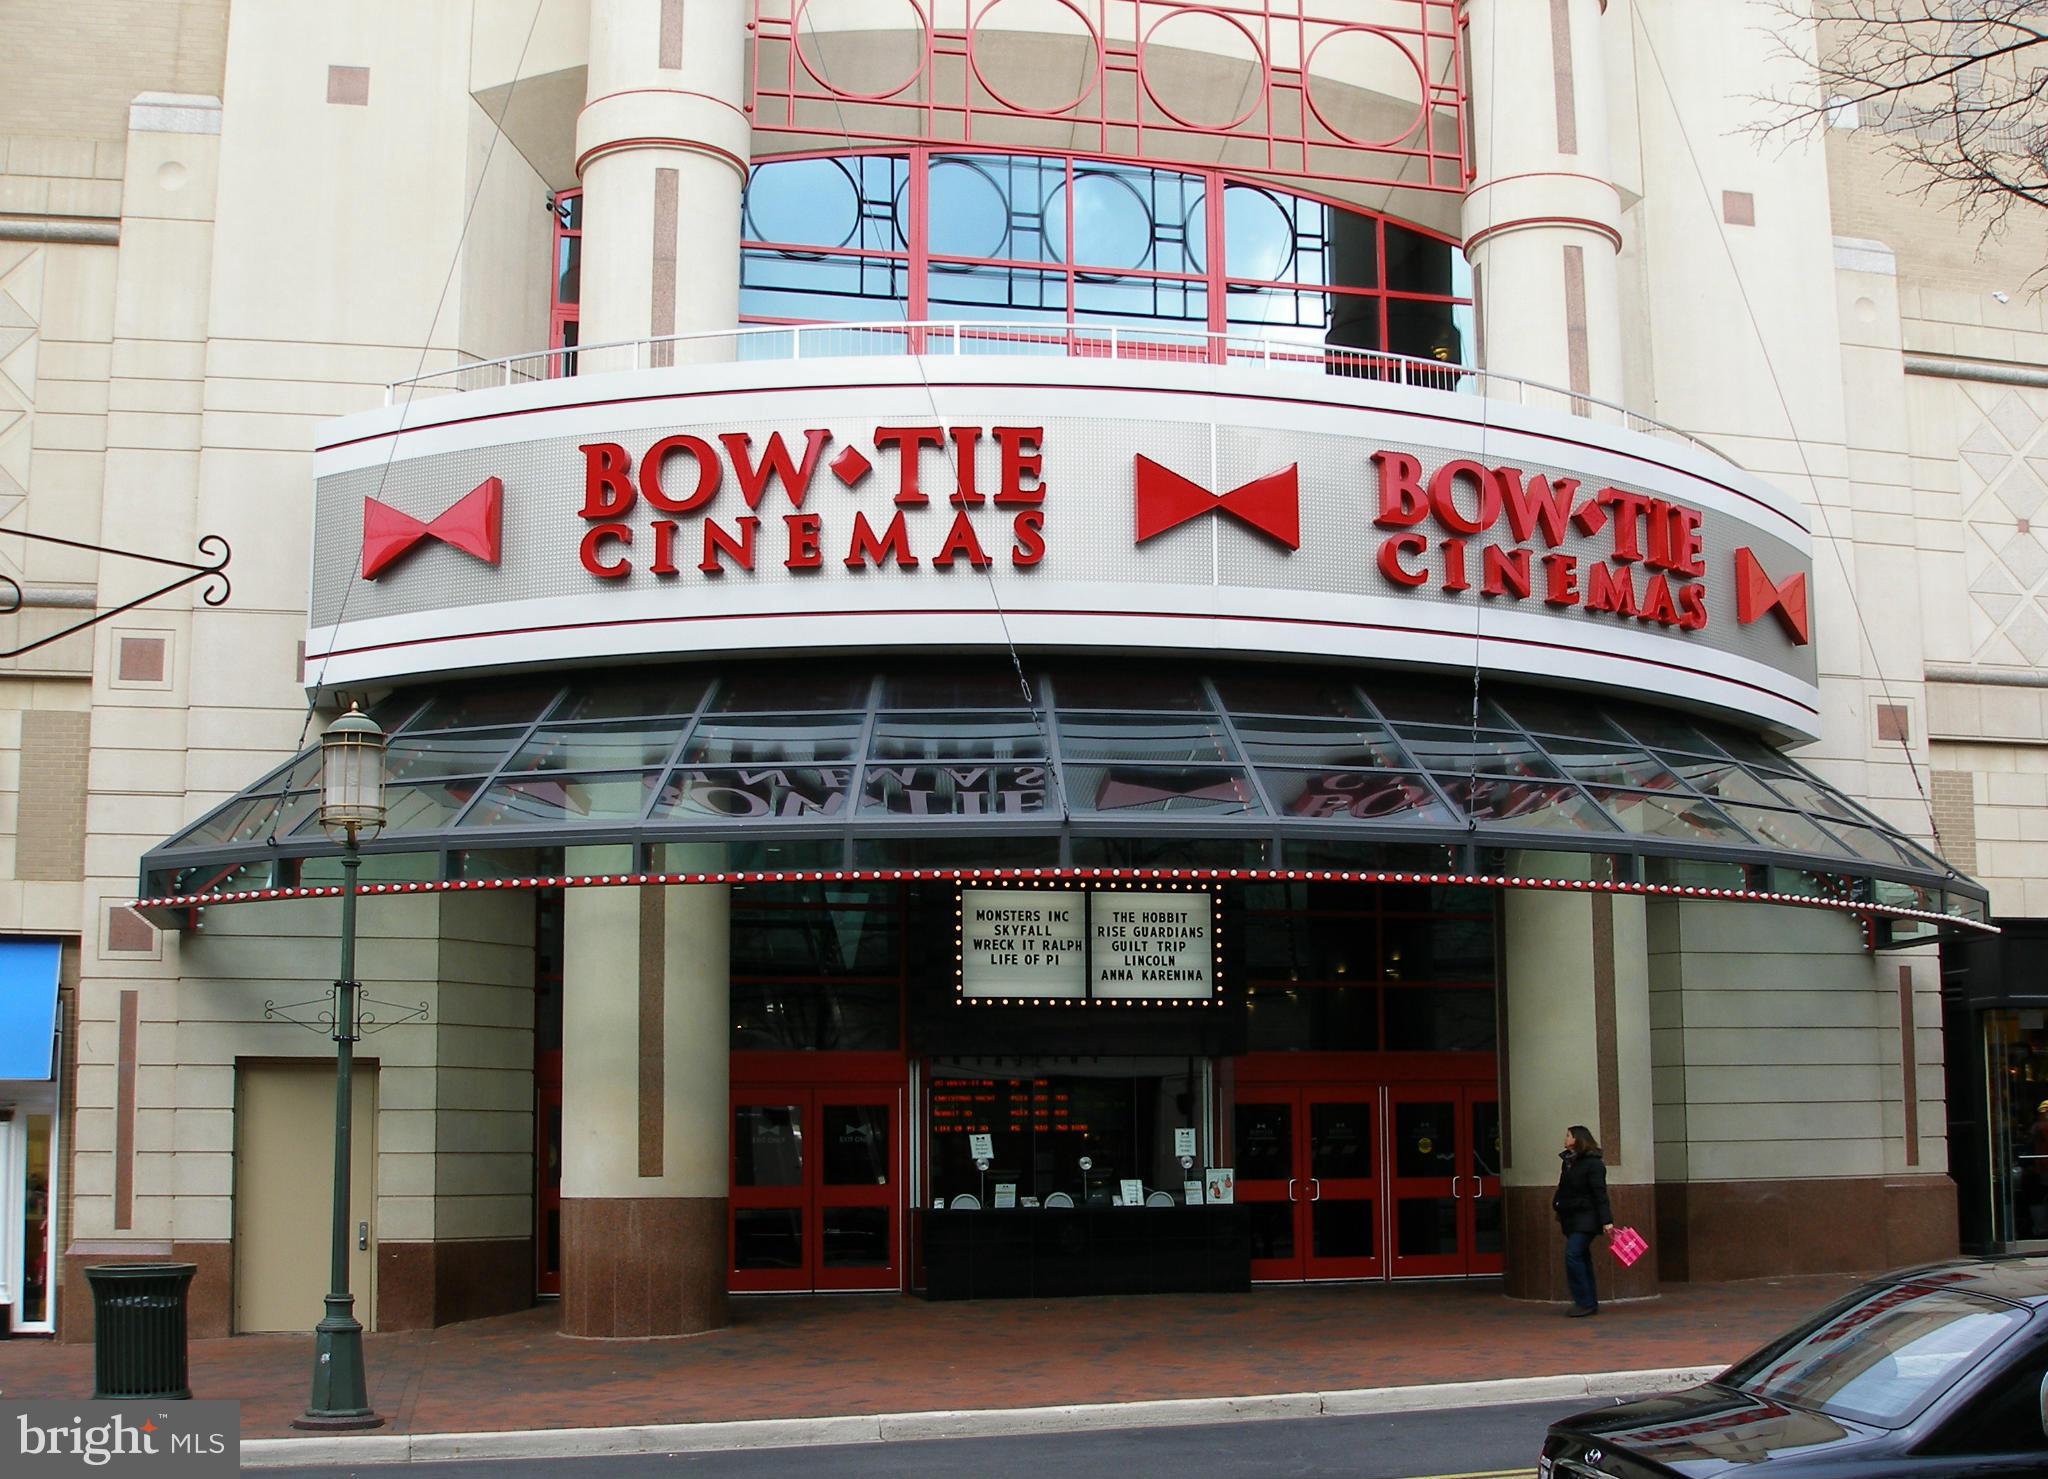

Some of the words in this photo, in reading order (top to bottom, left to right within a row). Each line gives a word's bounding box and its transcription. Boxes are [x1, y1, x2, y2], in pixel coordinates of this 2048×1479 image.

[577, 427, 833, 522] BOW
[873, 425, 1048, 506] TIE
[1370, 449, 1582, 550] BOW
[1599, 486, 1707, 579] TIE
[578, 507, 1047, 580] CINEMAS
[1376, 532, 1709, 632] CINEMAS
[976, 909, 1041, 922] MONSTERS
[1048, 910, 1070, 923] INC
[1112, 911, 1136, 924] THE
[1142, 911, 1188, 924] HOBBIT
[994, 924, 1052, 937] SKYFALL
[1097, 925, 1126, 938] RISE
[1133, 926, 1204, 939] GUARDIANS
[973, 938, 1015, 951] WRECK
[1022, 939, 1035, 951] IT
[1042, 939, 1083, 952] RALPH
[1111, 940, 1149, 952] GUILT
[1156, 940, 1186, 953] TRIP
[990, 953, 1018, 966] LIFE
[1024, 953, 1040, 966] OF
[1046, 954, 1060, 966] PI
[1124, 954, 1175, 967] LINCOLN
[1100, 969, 1134, 981] ANNA
[1141, 969, 1203, 981] KARENINA
